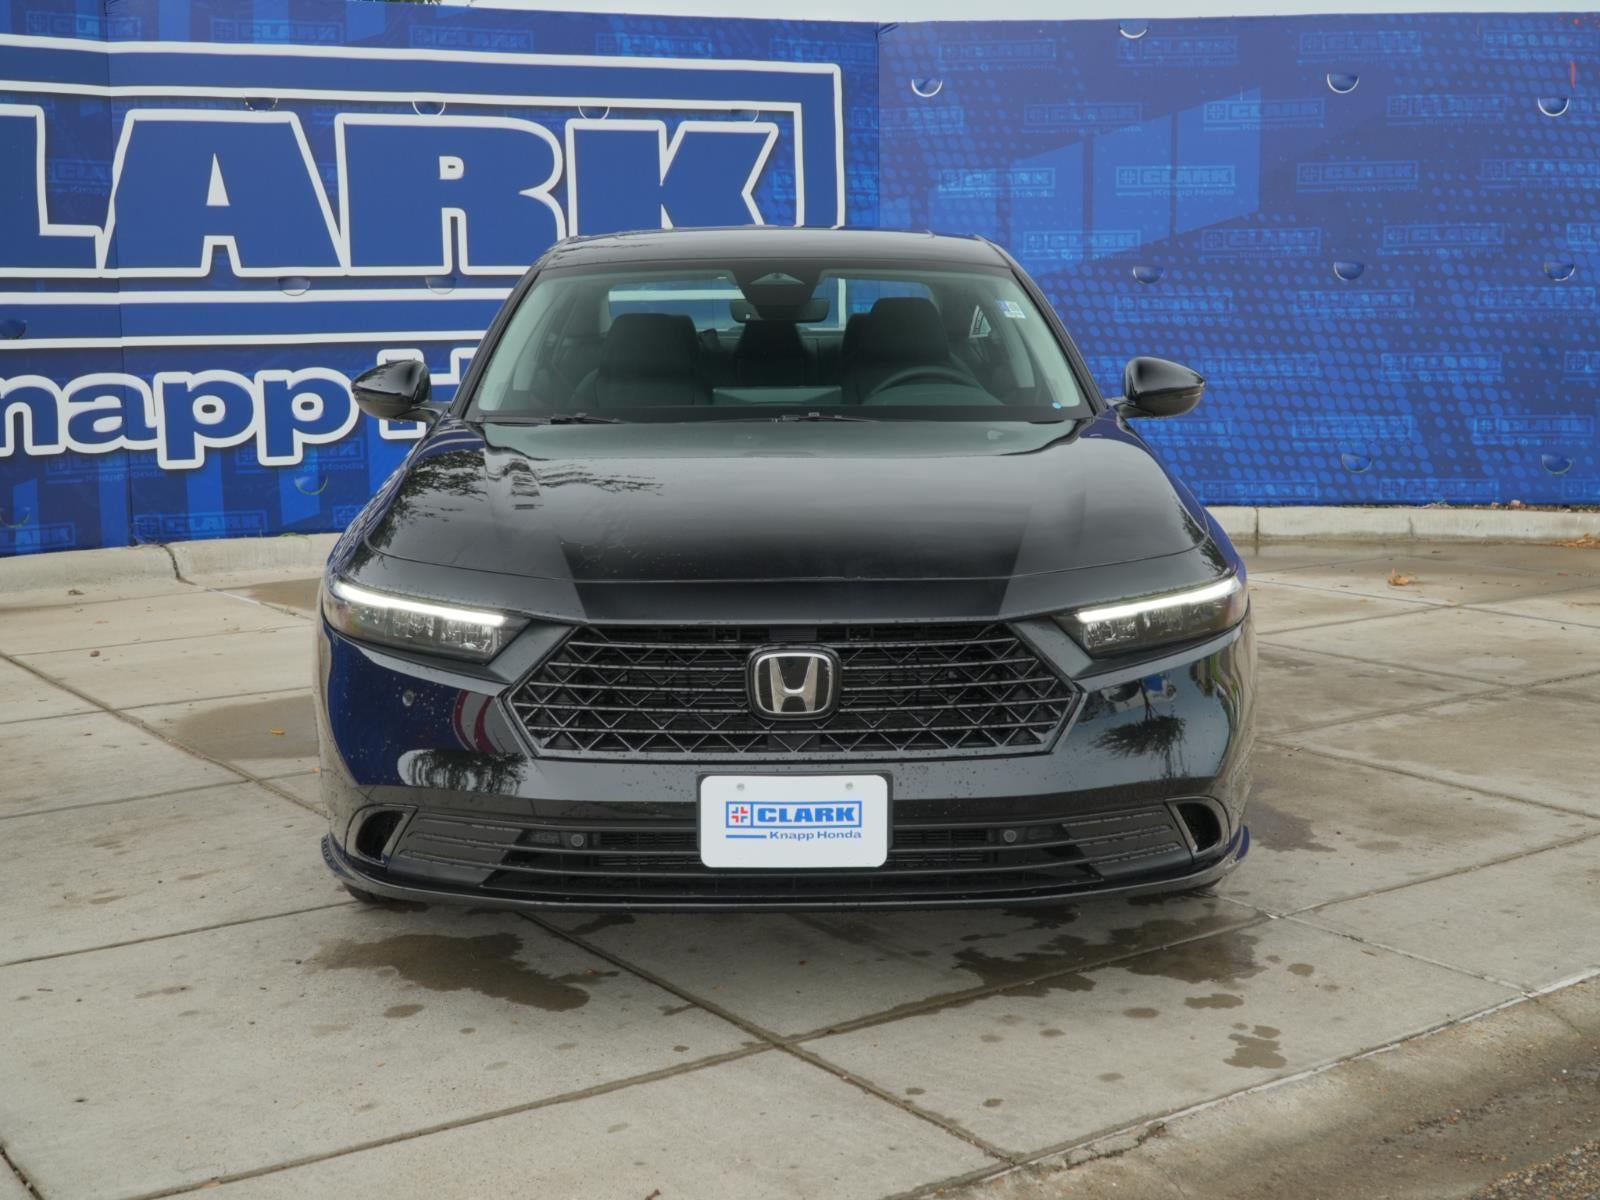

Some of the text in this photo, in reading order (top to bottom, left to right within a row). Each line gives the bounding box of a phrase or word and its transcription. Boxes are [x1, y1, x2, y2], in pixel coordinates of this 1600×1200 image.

[757, 807, 855, 822] CLARK
[770, 830, 861, 841] Knapp Honda
